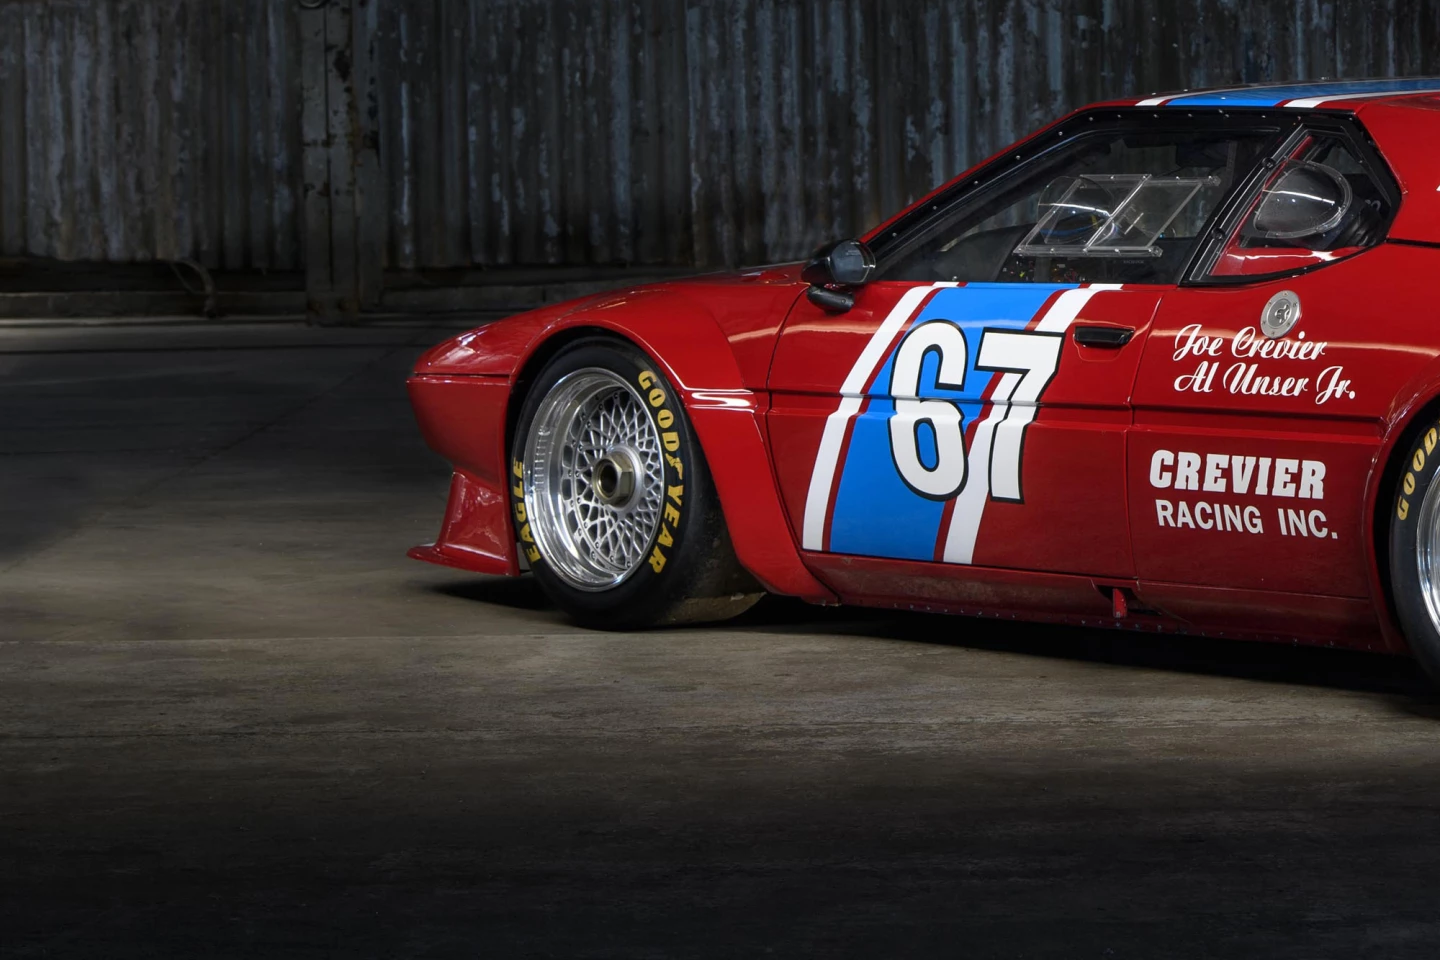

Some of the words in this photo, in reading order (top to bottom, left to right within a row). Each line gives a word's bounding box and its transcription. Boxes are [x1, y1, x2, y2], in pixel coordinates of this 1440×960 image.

[1173, 324, 1224, 361] Joe
[1231, 326, 1328, 361] Crevier
[1173, 361, 1220, 392] Al
[1222, 363, 1309, 397] Unser
[1315, 366, 1356, 405] Jr.
[887, 318, 1066, 504] 67
[638, 370, 684, 574] GOODYEAR
[1149, 449, 1327, 500] CREVIER
[513, 456, 542, 563] EAGLE
[1155, 499, 1264, 534] RACING
[1277, 508, 1339, 540] INC.
